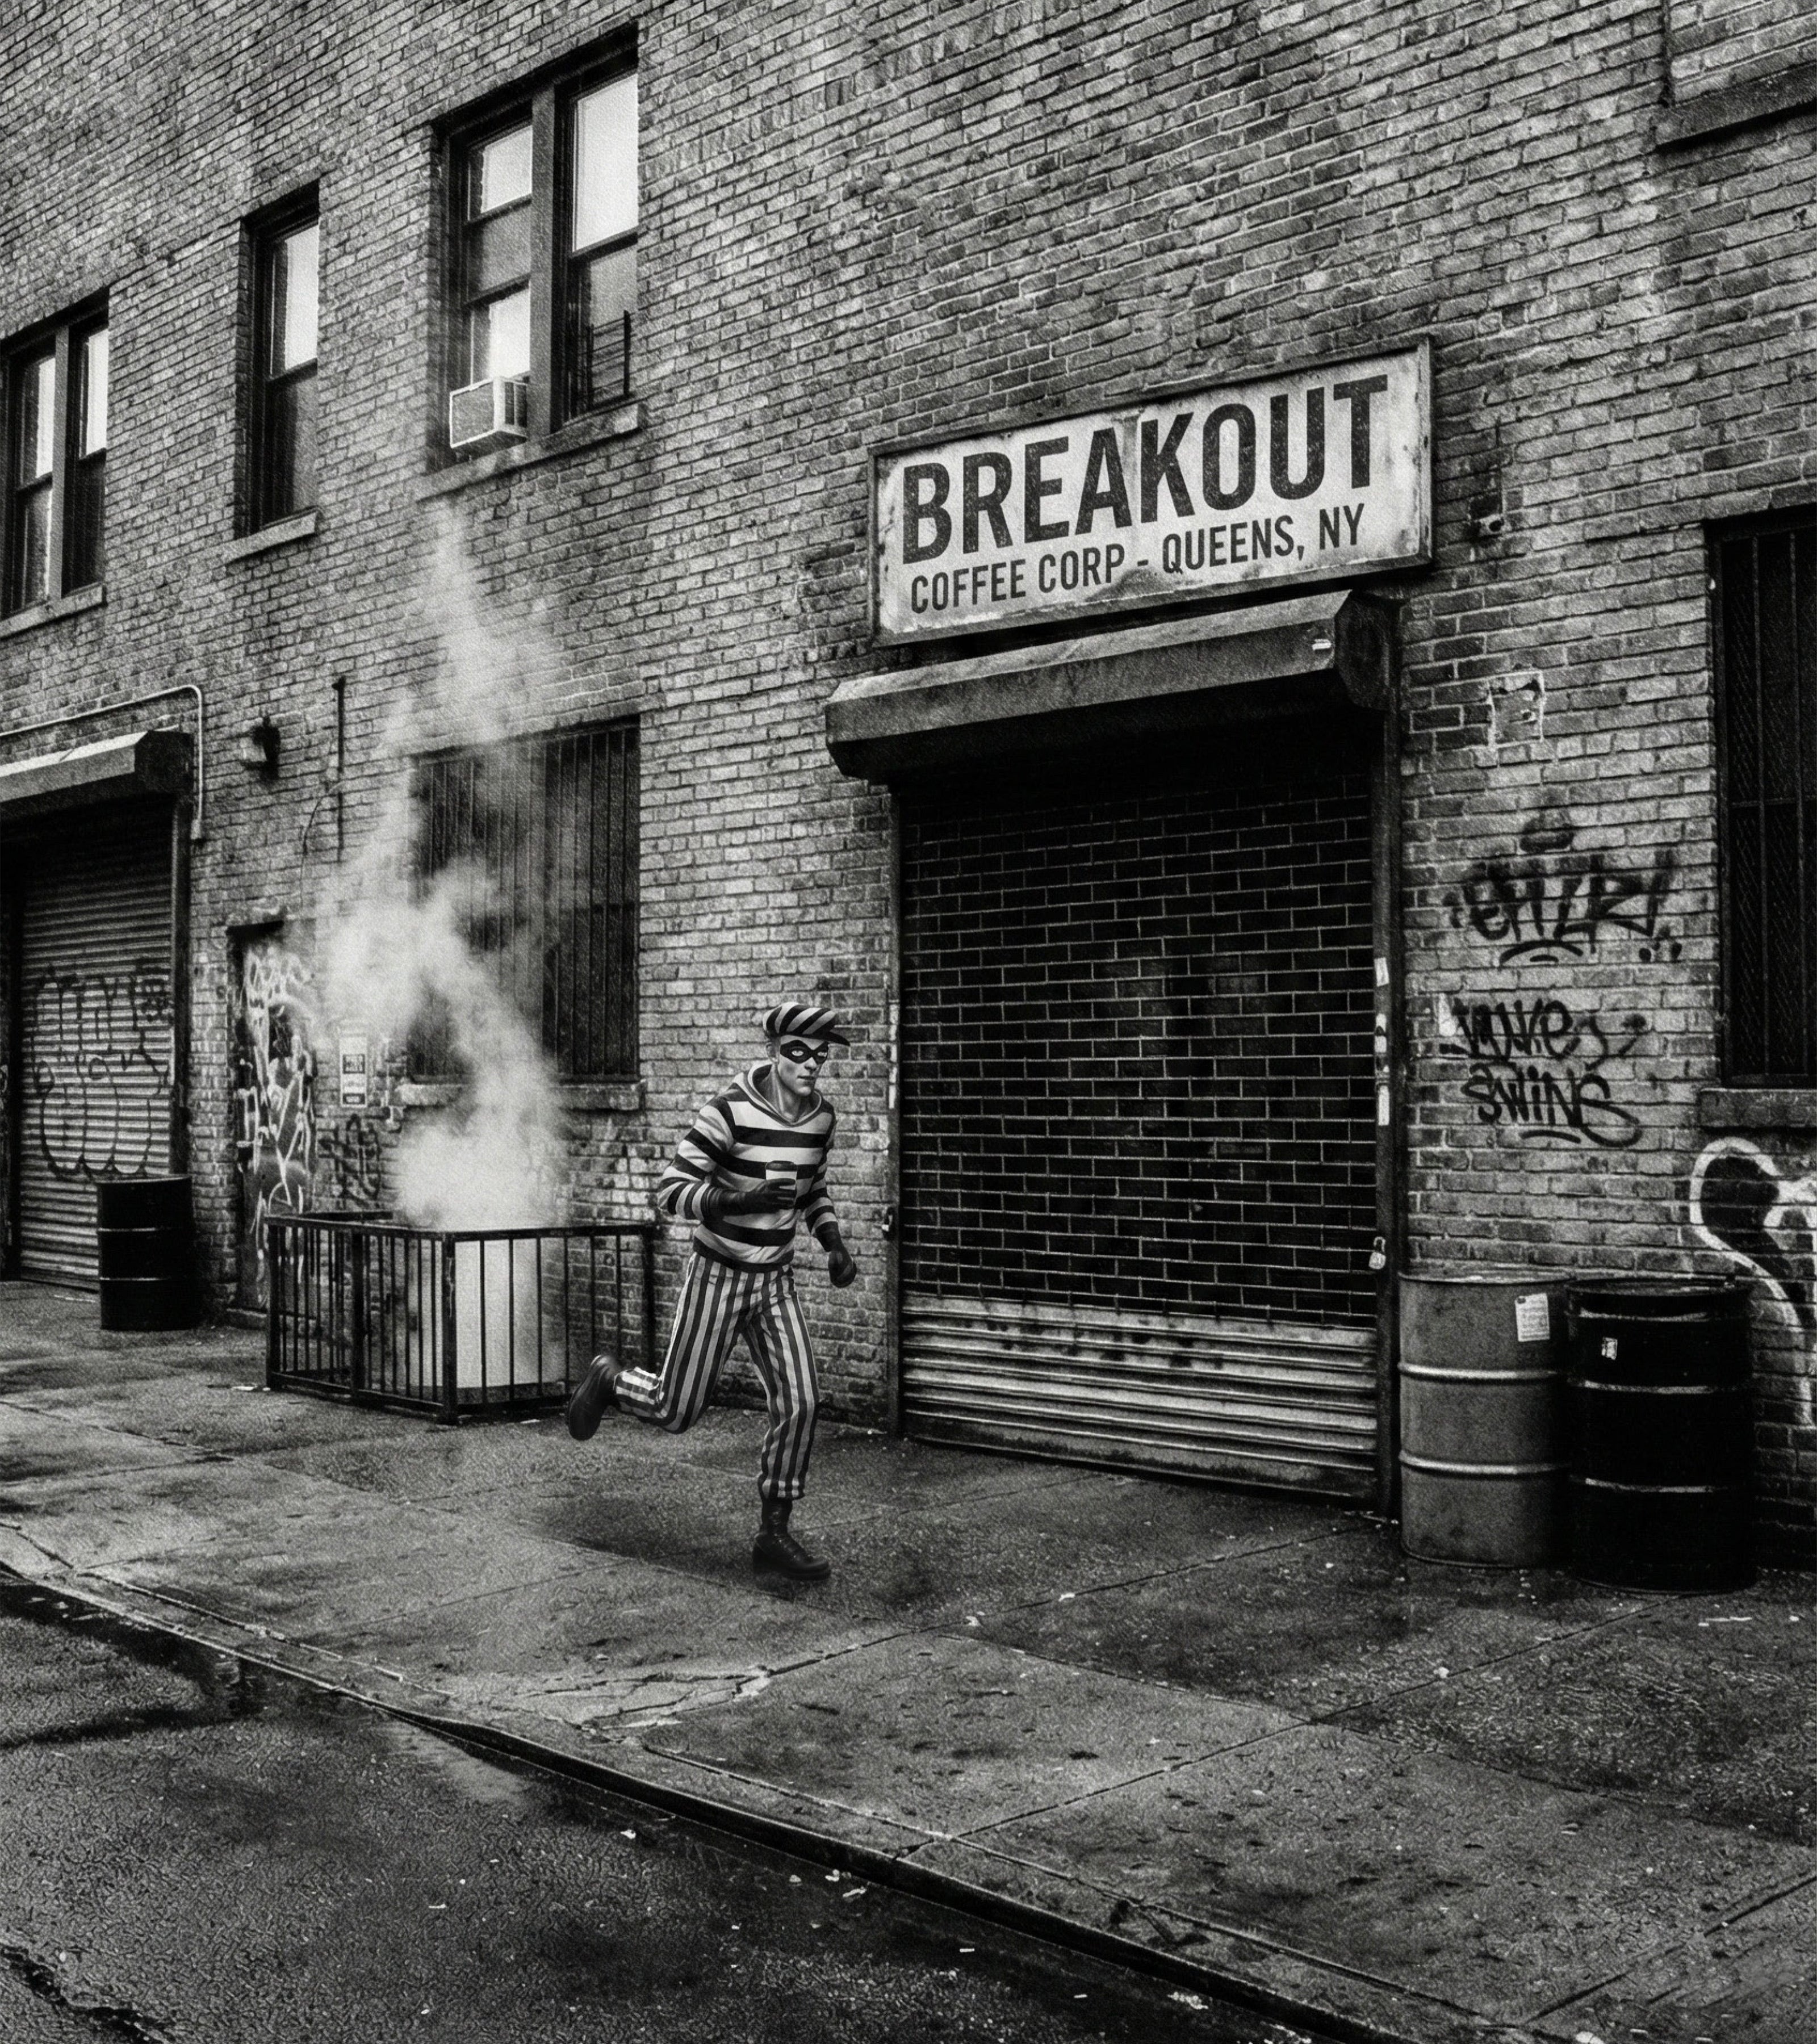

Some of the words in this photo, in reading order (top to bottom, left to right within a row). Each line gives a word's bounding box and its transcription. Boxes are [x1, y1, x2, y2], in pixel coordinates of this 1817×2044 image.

[903, 375, 1388, 564] BREAKOUT
[911, 559, 1027, 614] COFFEE
[1039, 544, 1125, 593] CORP
[1162, 516, 1305, 574] QUEENS,
[1320, 503, 1364, 550] NY
